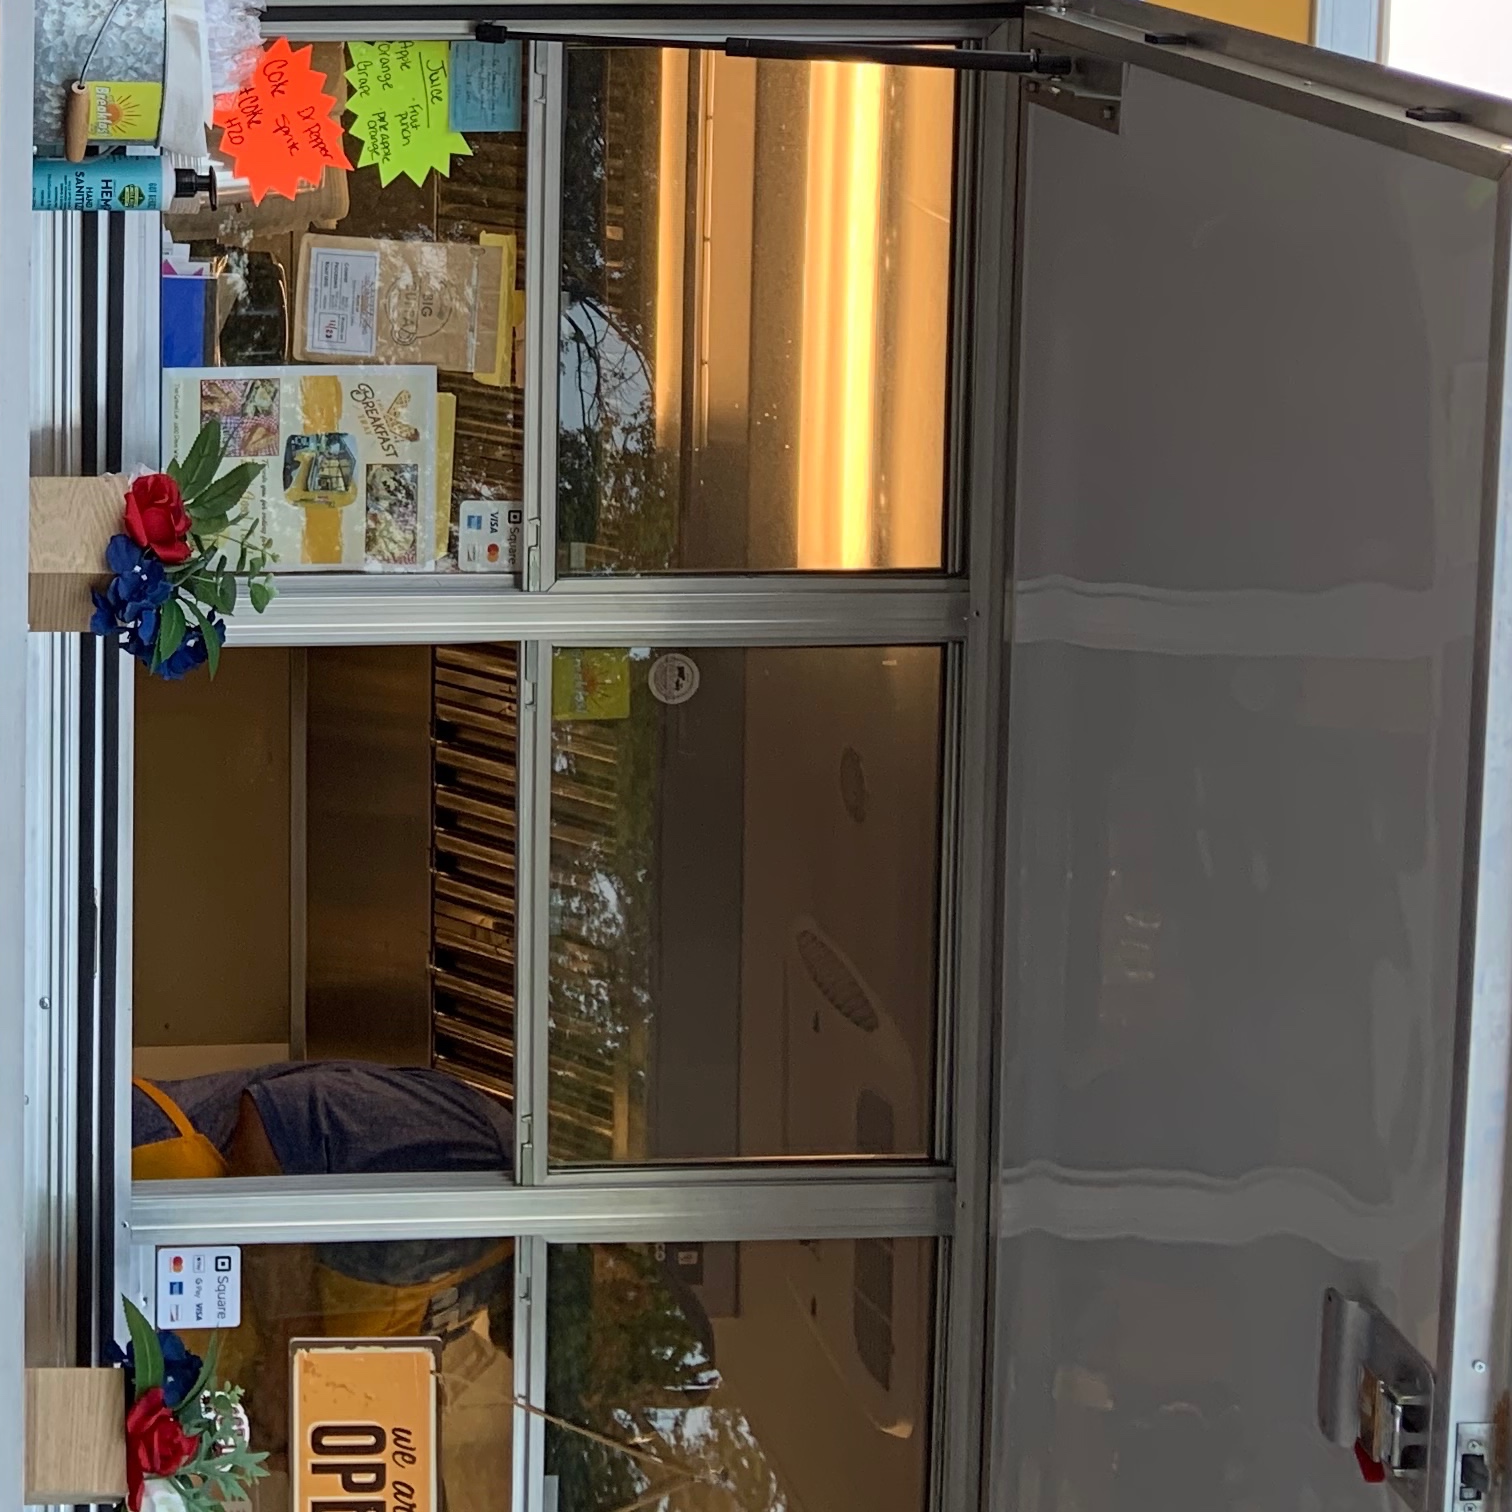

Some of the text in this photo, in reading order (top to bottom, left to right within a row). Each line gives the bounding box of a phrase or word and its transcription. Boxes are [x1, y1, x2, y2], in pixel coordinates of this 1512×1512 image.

[395, 40, 414, 71] Apple
[356, 60, 372, 98] Grape
[426, 60, 447, 104] Juice
[96, 87, 112, 136] Breakfast
[297, 106, 315, 120] Dr
[367, 120, 380, 161] orange
[421, 294, 433, 317] BIG
[350, 383, 399, 458] BREAKFAST
[490, 511, 499, 534] VISA
[507, 527, 520, 564] Square
[215, 1276, 228, 1319] Square
[392, 1428, 416, 1468] we
